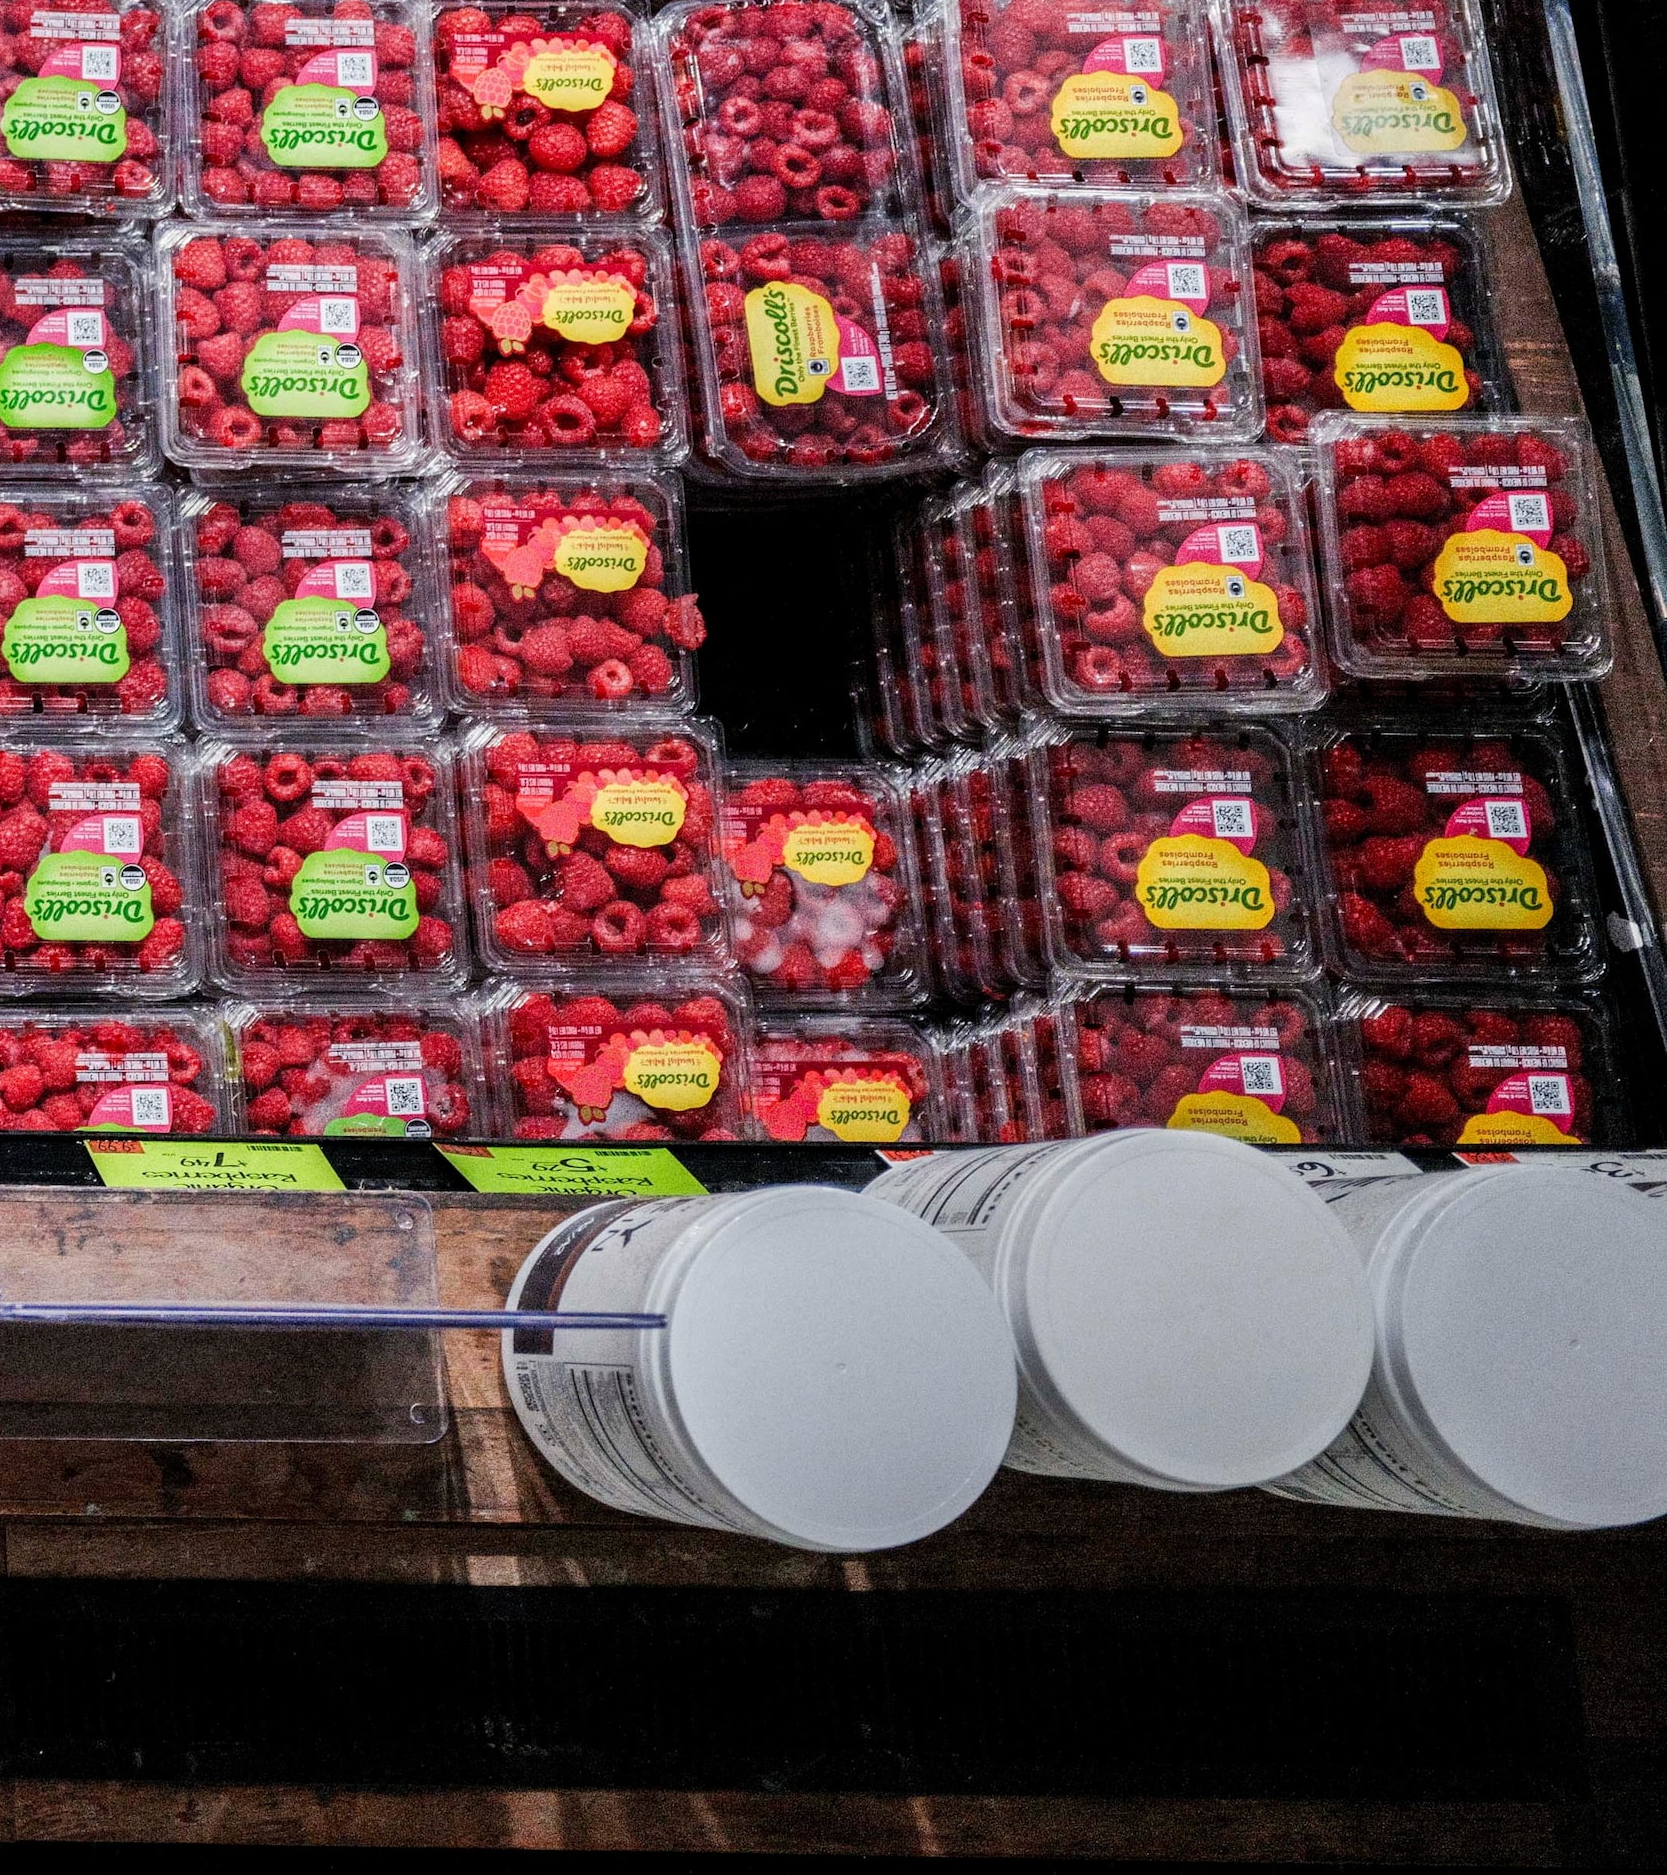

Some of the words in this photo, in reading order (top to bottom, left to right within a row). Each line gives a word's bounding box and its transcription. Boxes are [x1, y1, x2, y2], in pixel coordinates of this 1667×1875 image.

[535, 76, 602, 92] Driscoll's
[10, 121, 117, 144] Driscoll's
[268, 122, 377, 150] Driscoll's
[1060, 116, 1173, 139] Driscoll's
[555, 308, 623, 324] Driscoll's
[763, 290, 799, 398] Driscoll's
[1099, 344, 1215, 368] Driscoll's
[251, 367, 359, 399] Driscoll's
[1344, 369, 1458, 393] Driscoll's
[4, 381, 113, 412] Driscoll's
[568, 557, 637, 571] Driscoll's
[1165, 578, 1221, 587] Framboises
[1168, 587, 1226, 597] Raspberries
[1442, 578, 1560, 604] Driscoll's
[1194, 603, 1219, 611] Finest
[1221, 601, 1235, 610] the
[1235, 601, 1255, 610] Only
[1153, 611, 1273, 637] Driscoll's
[9, 643, 119, 664] Driscoll's
[272, 643, 380, 665] Driscoll's
[605, 811, 674, 824] Driscoll's
[295, 896, 410, 921] Driscoll's
[1146, 886, 1265, 910] Driscoll's
[1423, 887, 1543, 911] Driscoll's
[33, 898, 145, 923] Driscoll's
[643, 1073, 710, 1089] Driscoll's
[142, 1170, 298, 1183] Raspberries
[495, 1172, 653, 1186] Raspberries
